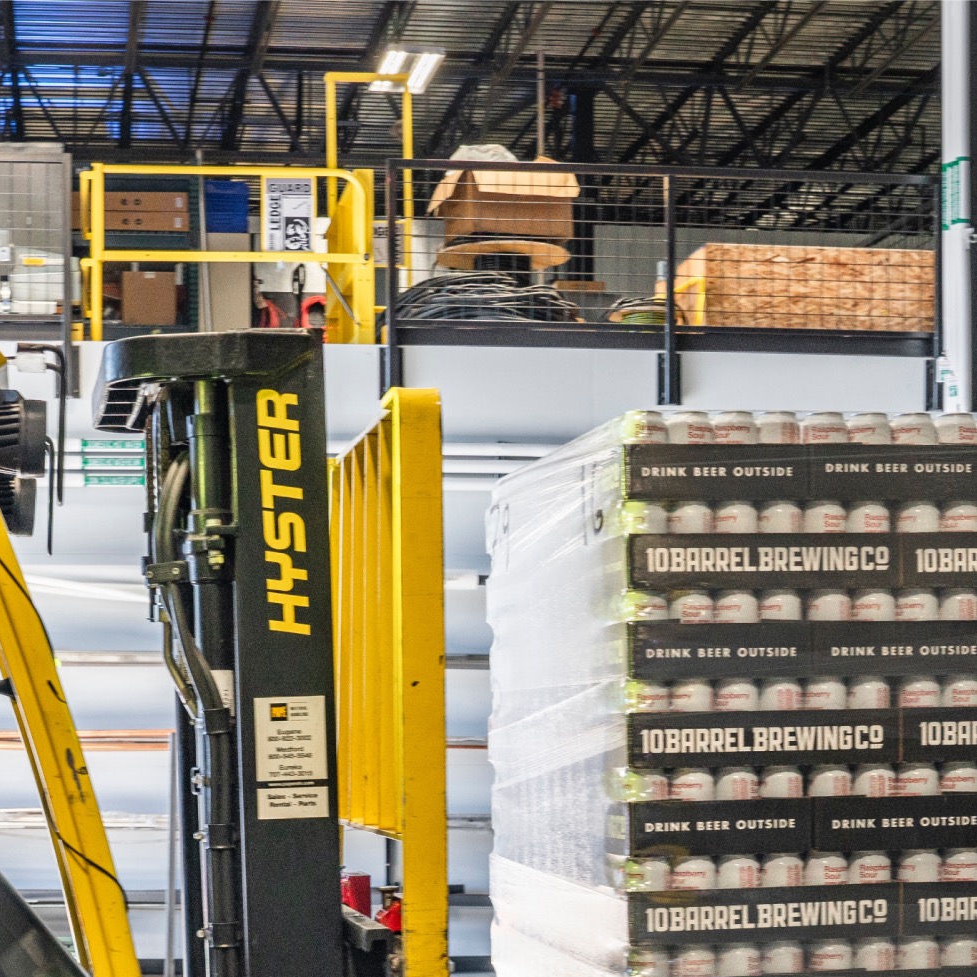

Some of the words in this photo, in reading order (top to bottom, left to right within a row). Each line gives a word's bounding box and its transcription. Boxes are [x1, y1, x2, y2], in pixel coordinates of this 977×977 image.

[269, 194, 282, 231] LEDGE
[641, 467, 687, 477] DRINK
[693, 467, 727, 477] BEER
[733, 466, 793, 476] OUTSIDE
[825, 463, 869, 473] DRINK
[875, 463, 908, 473] BEER
[914, 463, 972, 473] OUTSIDE
[256, 388, 312, 636] HYSTER
[646, 648, 691, 658] DRINK
[697, 648, 731, 658] BEER
[737, 647, 797, 657] OUTSIDE
[831, 646, 875, 657] DRINK
[881, 646, 914, 656] BEER
[919, 645, 977, 656] OUTSIDE
[644, 821, 690, 832] DRINK
[696, 820, 730, 831] BEER
[735, 818, 796, 830] OUTSIDE
[832, 818, 876, 829] DRINK
[882, 817, 914, 828] BEER
[920, 815, 977, 827] OUTSIDE
